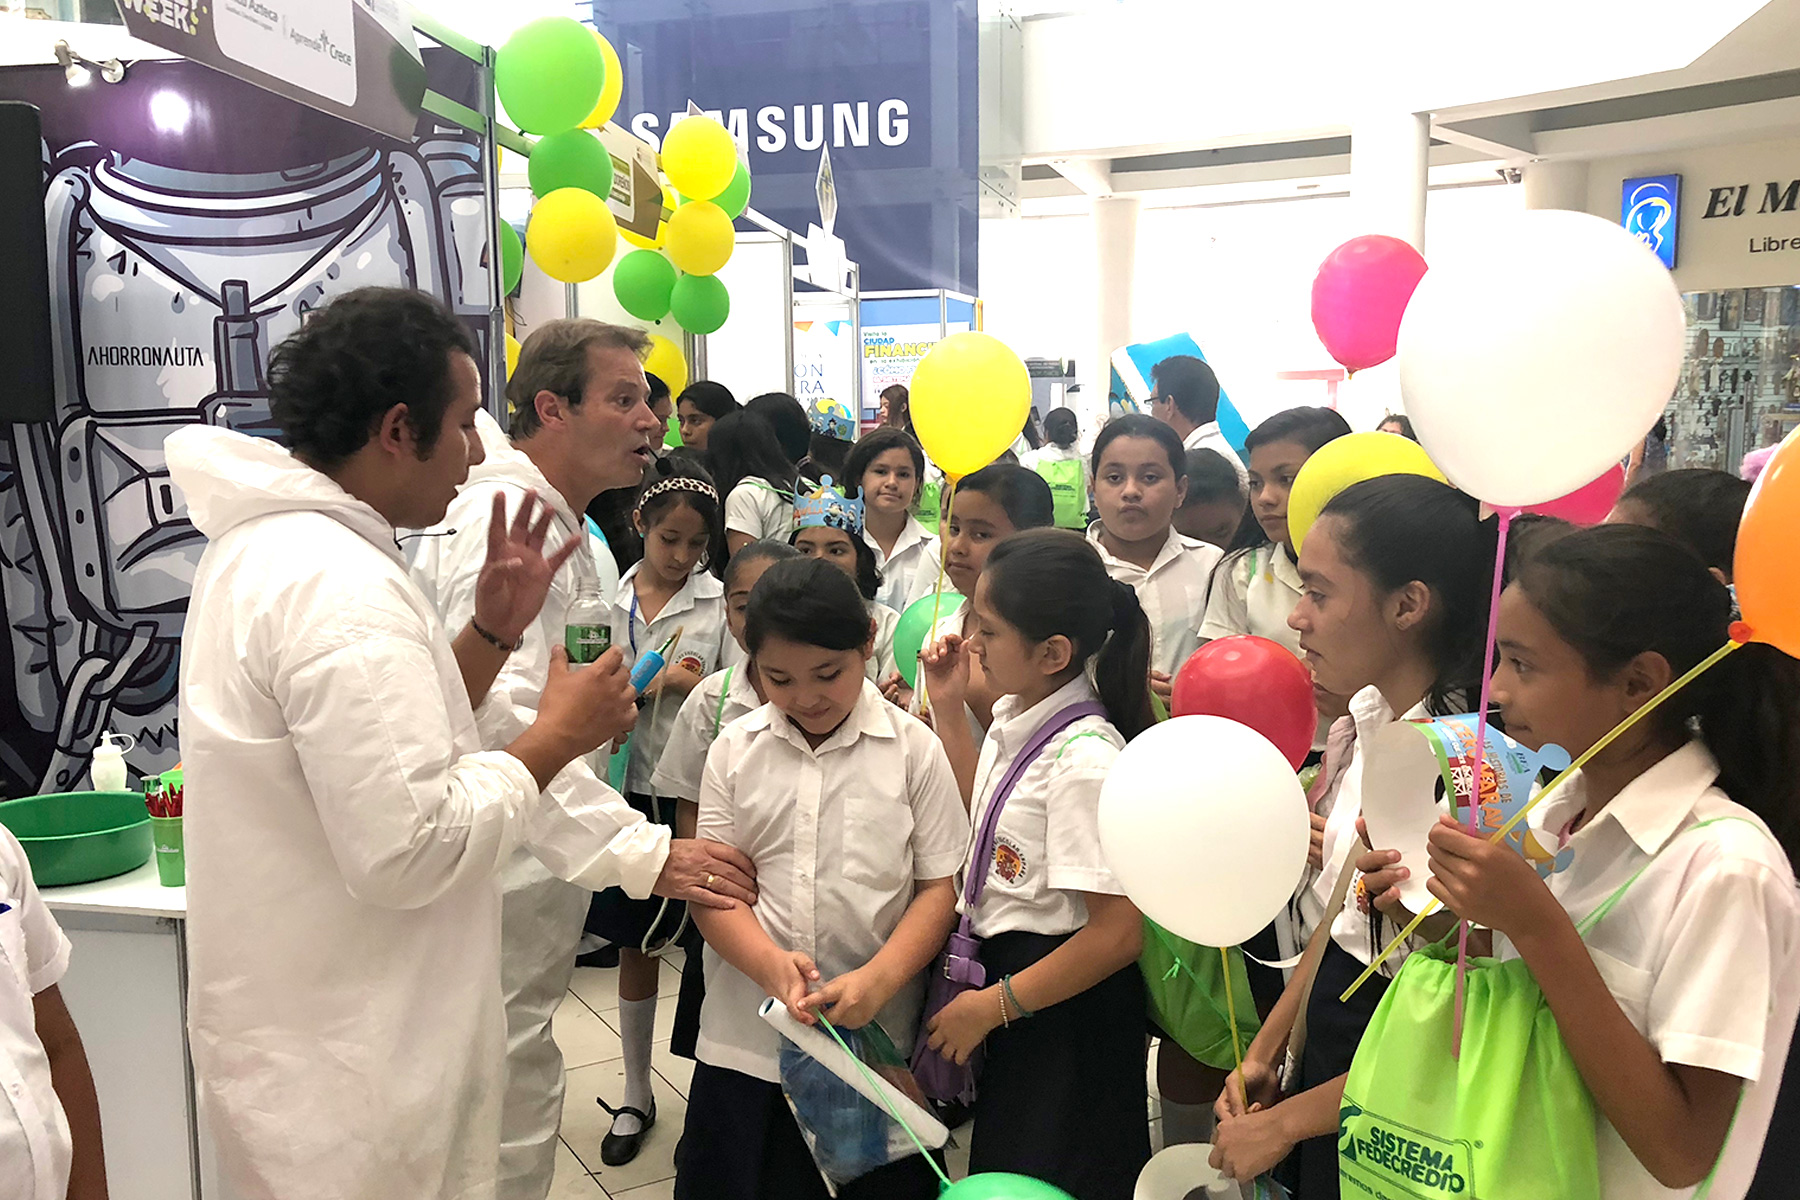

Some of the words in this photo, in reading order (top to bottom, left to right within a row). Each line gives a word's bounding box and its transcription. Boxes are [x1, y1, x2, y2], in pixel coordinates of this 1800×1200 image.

[249, 0, 278, 23] Azteca
[329, 43, 352, 66] Crece
[631, 99, 909, 153] SMSUNG
[1701, 184, 1750, 219] El
[1749, 236, 1800, 253] Libre
[863, 337, 895, 346] CIUDAD
[864, 342, 936, 359] FINANC
[88, 346, 204, 366] AHORRONAUTA
[794, 380, 825, 394] RA
[1370, 1126, 1453, 1172] SISTEMA
[1356, 1138, 1465, 1193] FEDECREDIO
